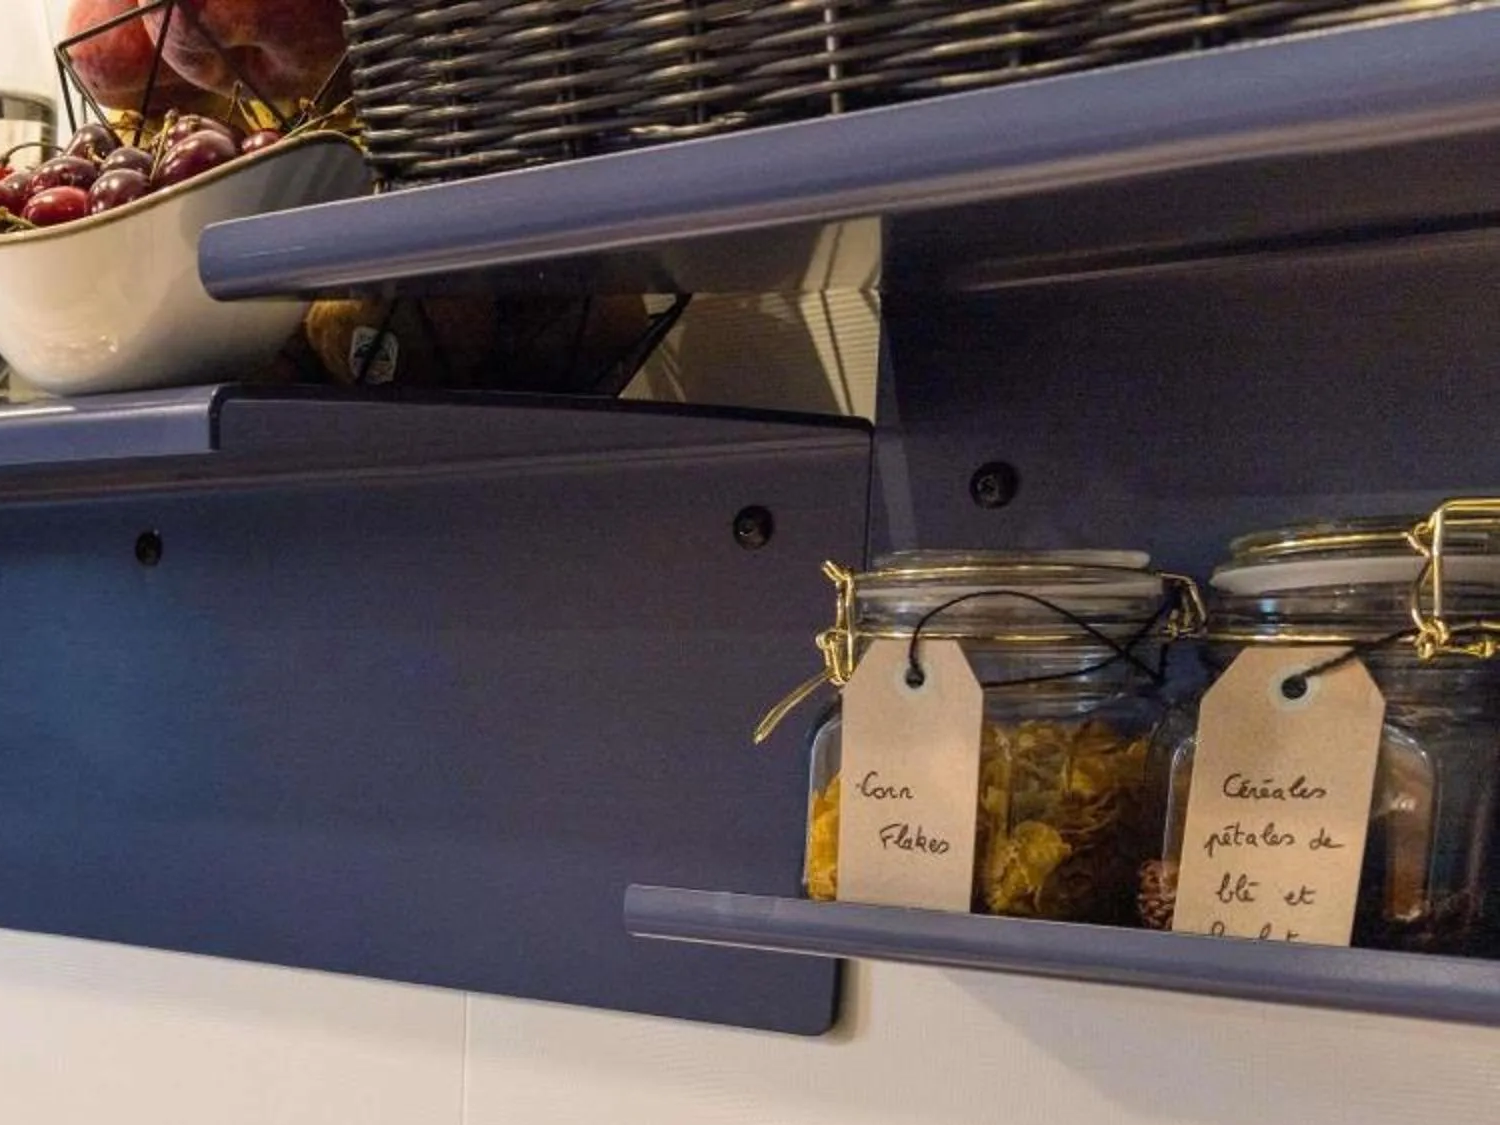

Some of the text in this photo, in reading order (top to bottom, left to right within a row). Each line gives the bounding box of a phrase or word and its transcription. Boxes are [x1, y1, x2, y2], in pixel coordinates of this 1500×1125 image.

[860, 770, 914, 800] Corn
[1222, 773, 1328, 801] Céréales
[879, 823, 950, 855] Flakes
[1203, 822, 1346, 858] pétales de
[1215, 871, 1317, 907] blé et
